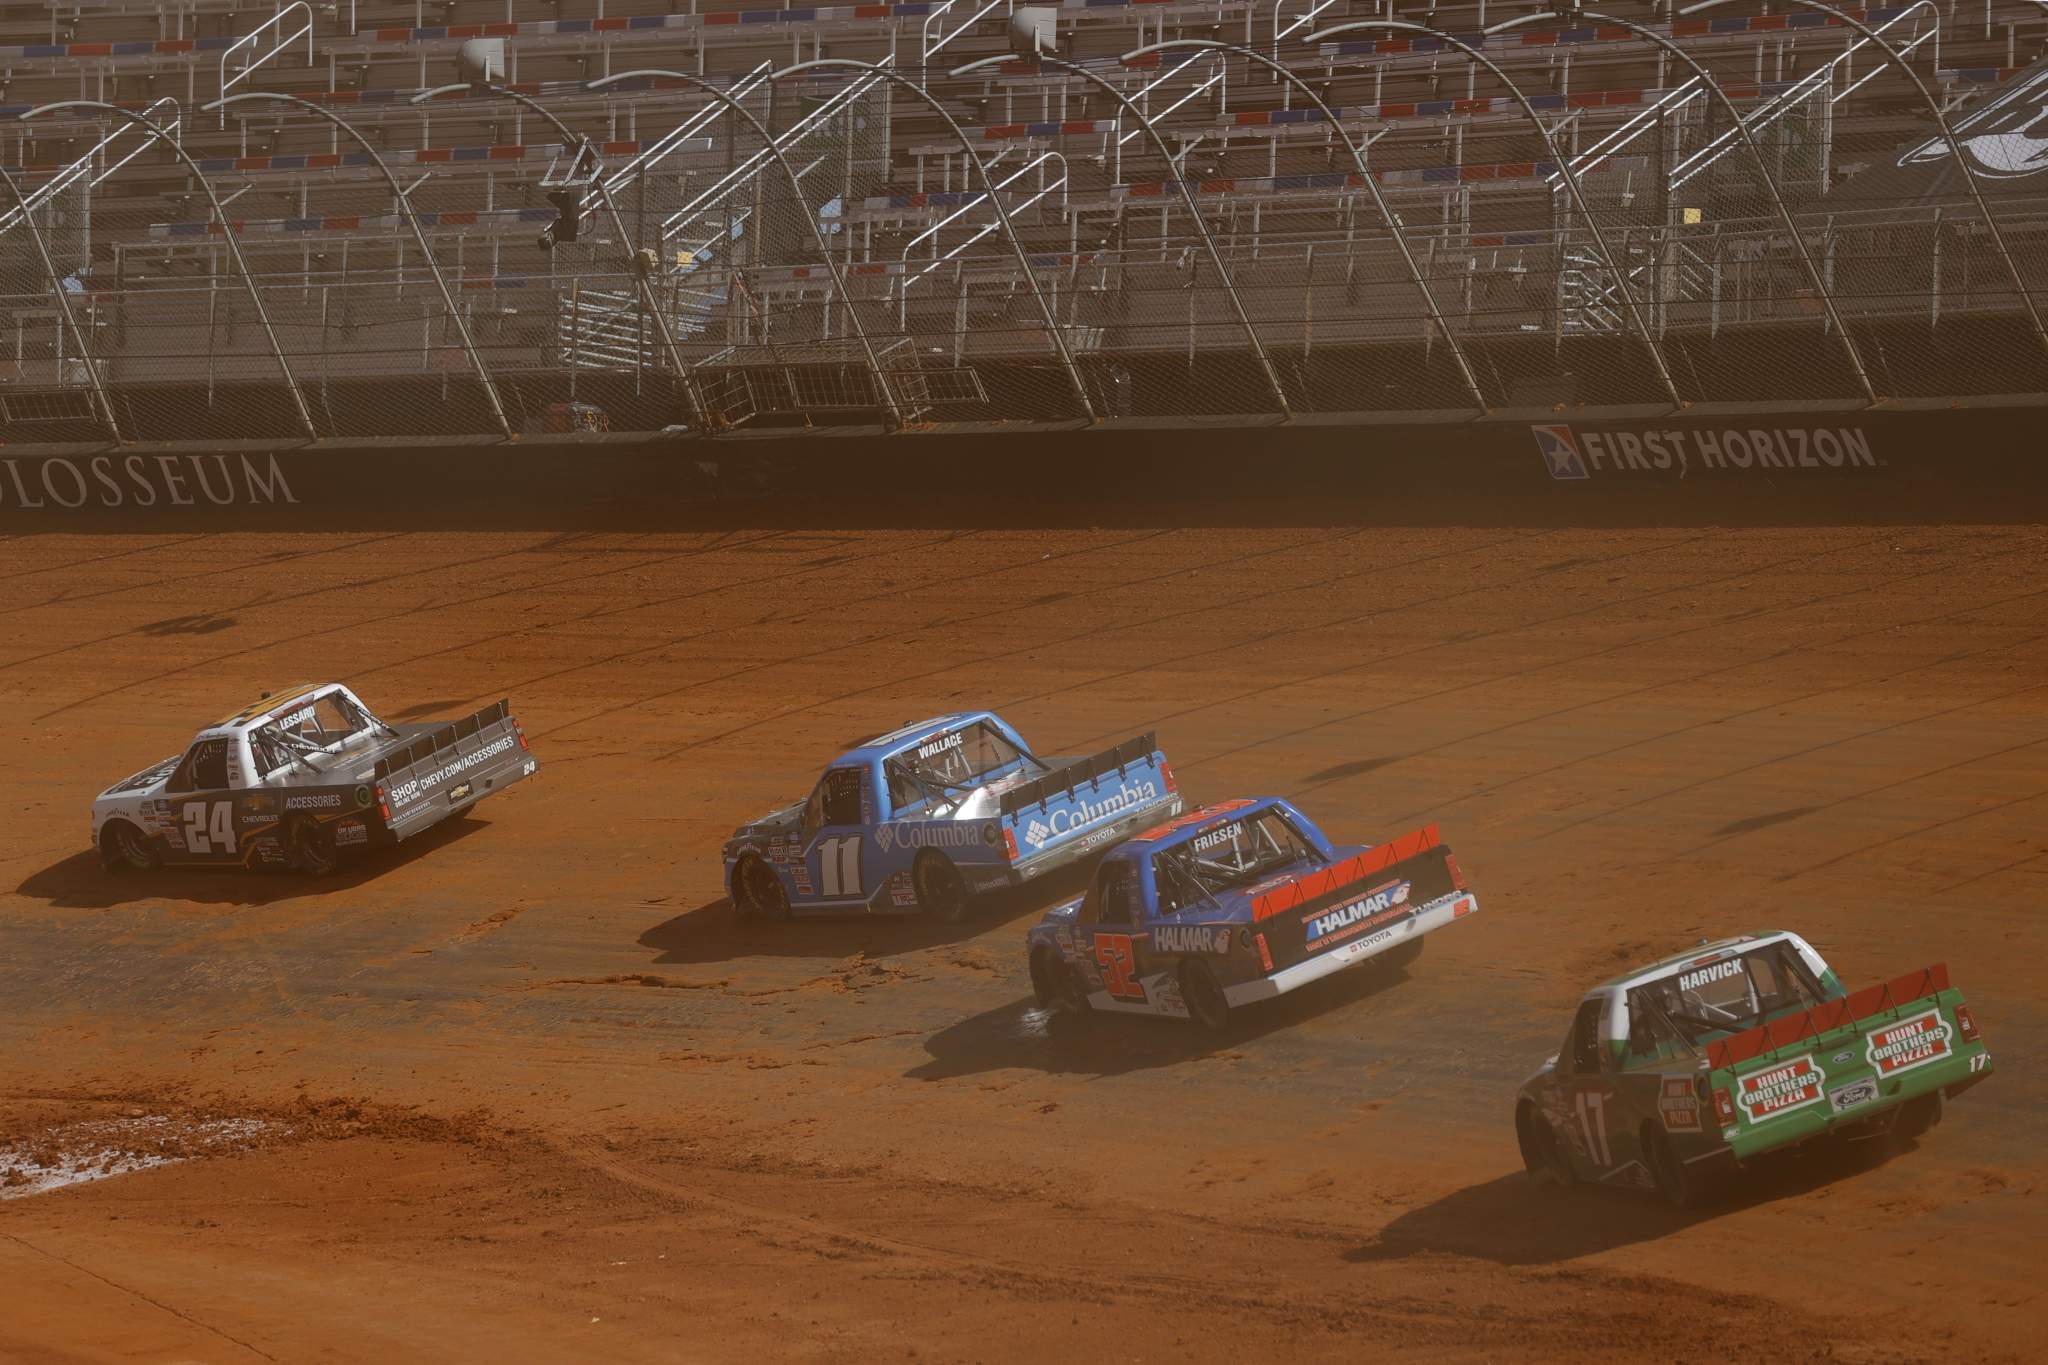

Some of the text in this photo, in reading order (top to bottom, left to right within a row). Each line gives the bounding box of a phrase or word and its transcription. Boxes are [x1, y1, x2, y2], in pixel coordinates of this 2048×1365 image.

[1580, 427, 1876, 471] FIRST HORIZON
[0, 452, 300, 508] LOSSEUM
[279, 704, 317, 731] LESSARD
[918, 732, 963, 759] WALLACE
[419, 735, 515, 790] CHEVY.COM/ACCESSORIES
[523, 761, 537, 776] 24
[285, 794, 341, 809] ACCESSORIES
[390, 780, 418, 801] SHOP
[1050, 778, 1157, 835] Columbia
[1170, 802, 1183, 817] 11
[183, 801, 238, 854] 24
[895, 821, 979, 848] Columbia
[1086, 827, 1117, 845] TOYOTA
[1194, 821, 1242, 853] FRIESEN
[817, 836, 862, 897] 11
[1314, 892, 1391, 936] HALMAR
[1154, 927, 1214, 952] HALMAR
[1357, 931, 1392, 949] TOYOTA
[1093, 932, 1146, 999] 52
[1679, 957, 1744, 992] HARVICK
[1873, 1029, 1946, 1060] BROTHERS
[1886, 1020, 1927, 1045] HUNT
[1890, 1044, 1936, 1068] PIZZA
[1968, 1053, 1985, 1073] 17
[1745, 1073, 1818, 1105] BROTHERS
[1756, 1064, 1799, 1089] HUNT
[1763, 1088, 1807, 1113] PIZZA
[1576, 1091, 1613, 1168] 17
